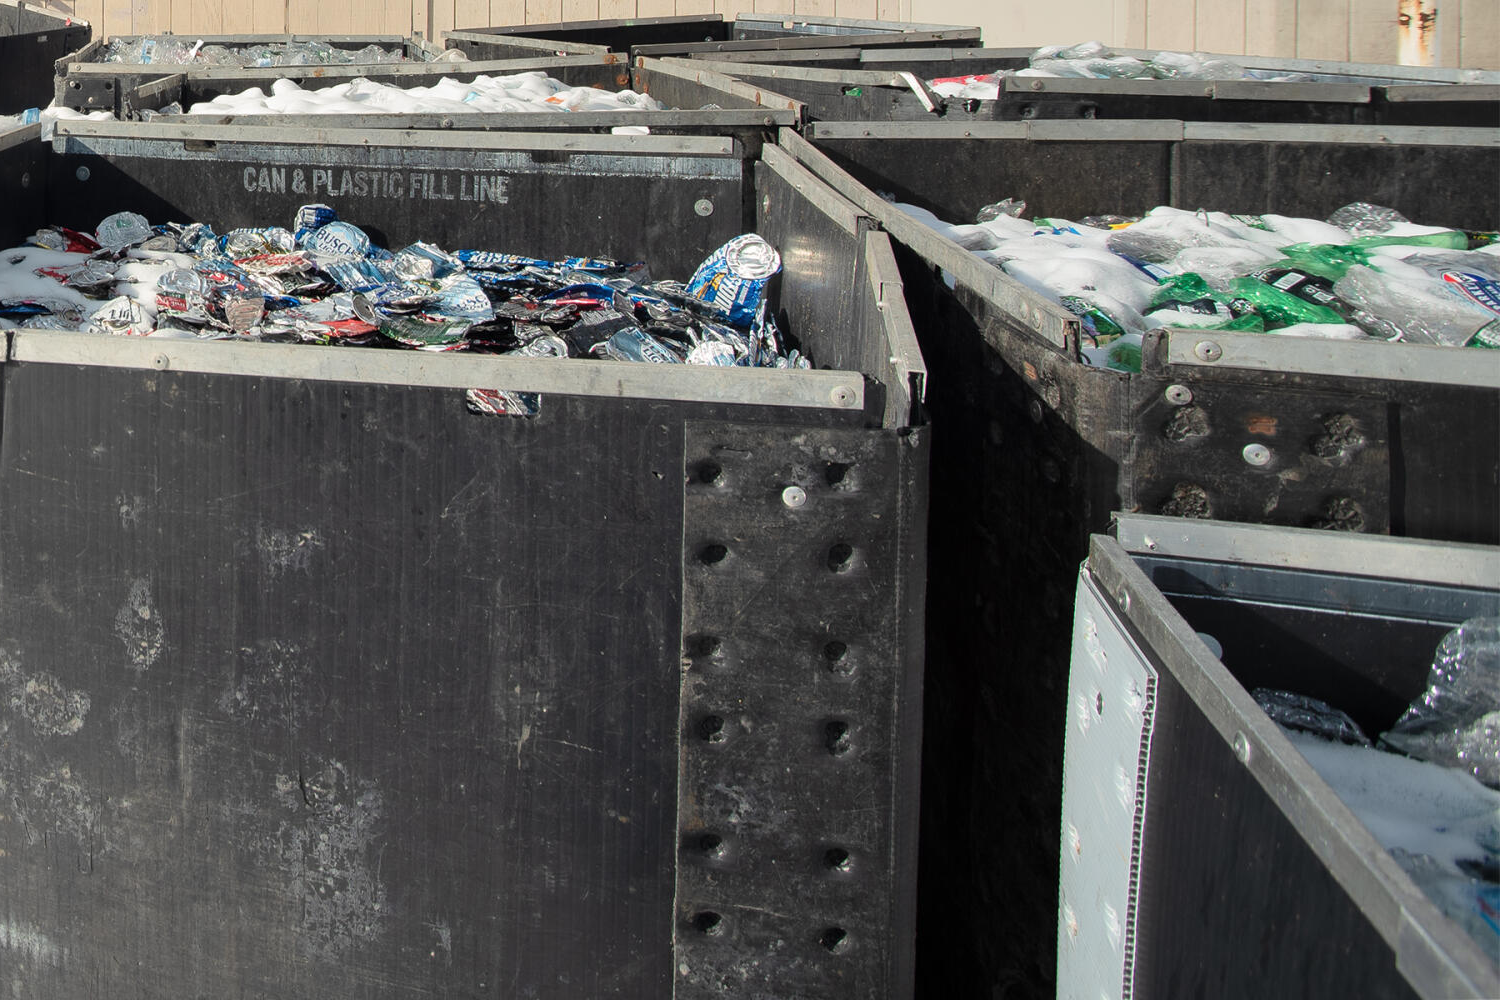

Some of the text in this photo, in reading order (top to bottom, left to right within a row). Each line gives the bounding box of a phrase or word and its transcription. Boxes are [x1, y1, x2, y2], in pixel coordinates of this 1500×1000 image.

[243, 166, 509, 204] CAN & PLASTIC FILL LINE
[316, 229, 356, 255] BUSCH
